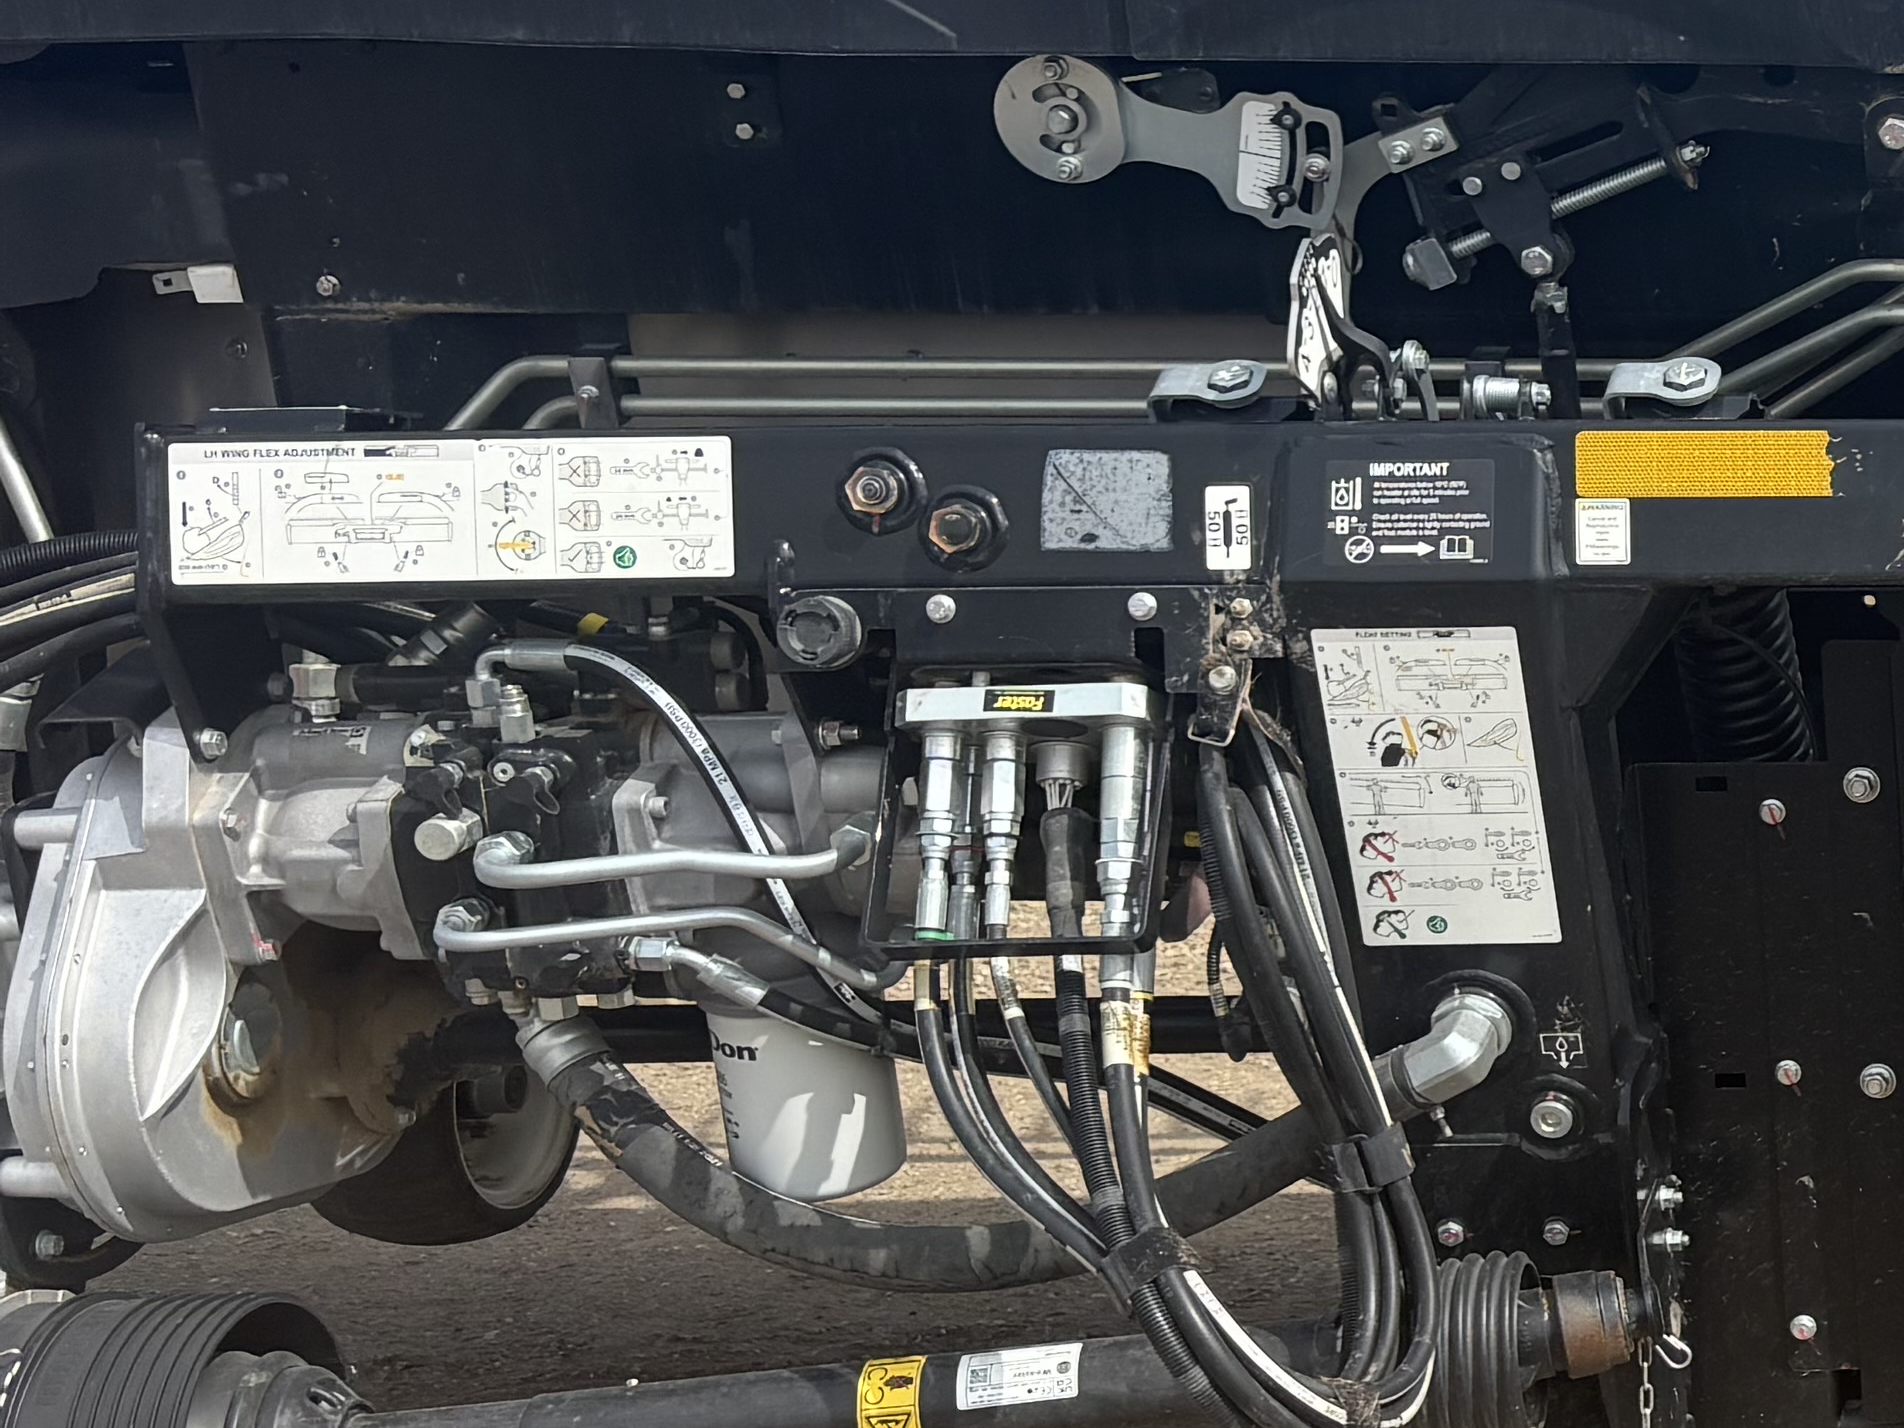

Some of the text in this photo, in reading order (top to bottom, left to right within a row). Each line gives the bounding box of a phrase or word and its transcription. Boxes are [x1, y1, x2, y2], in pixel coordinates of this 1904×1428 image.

[1369, 463, 1449, 476] IMPORTANT
[993, 695, 1045, 711] Faster
[701, 747, 722, 771] MPa
[714, 772, 727, 785] 21
